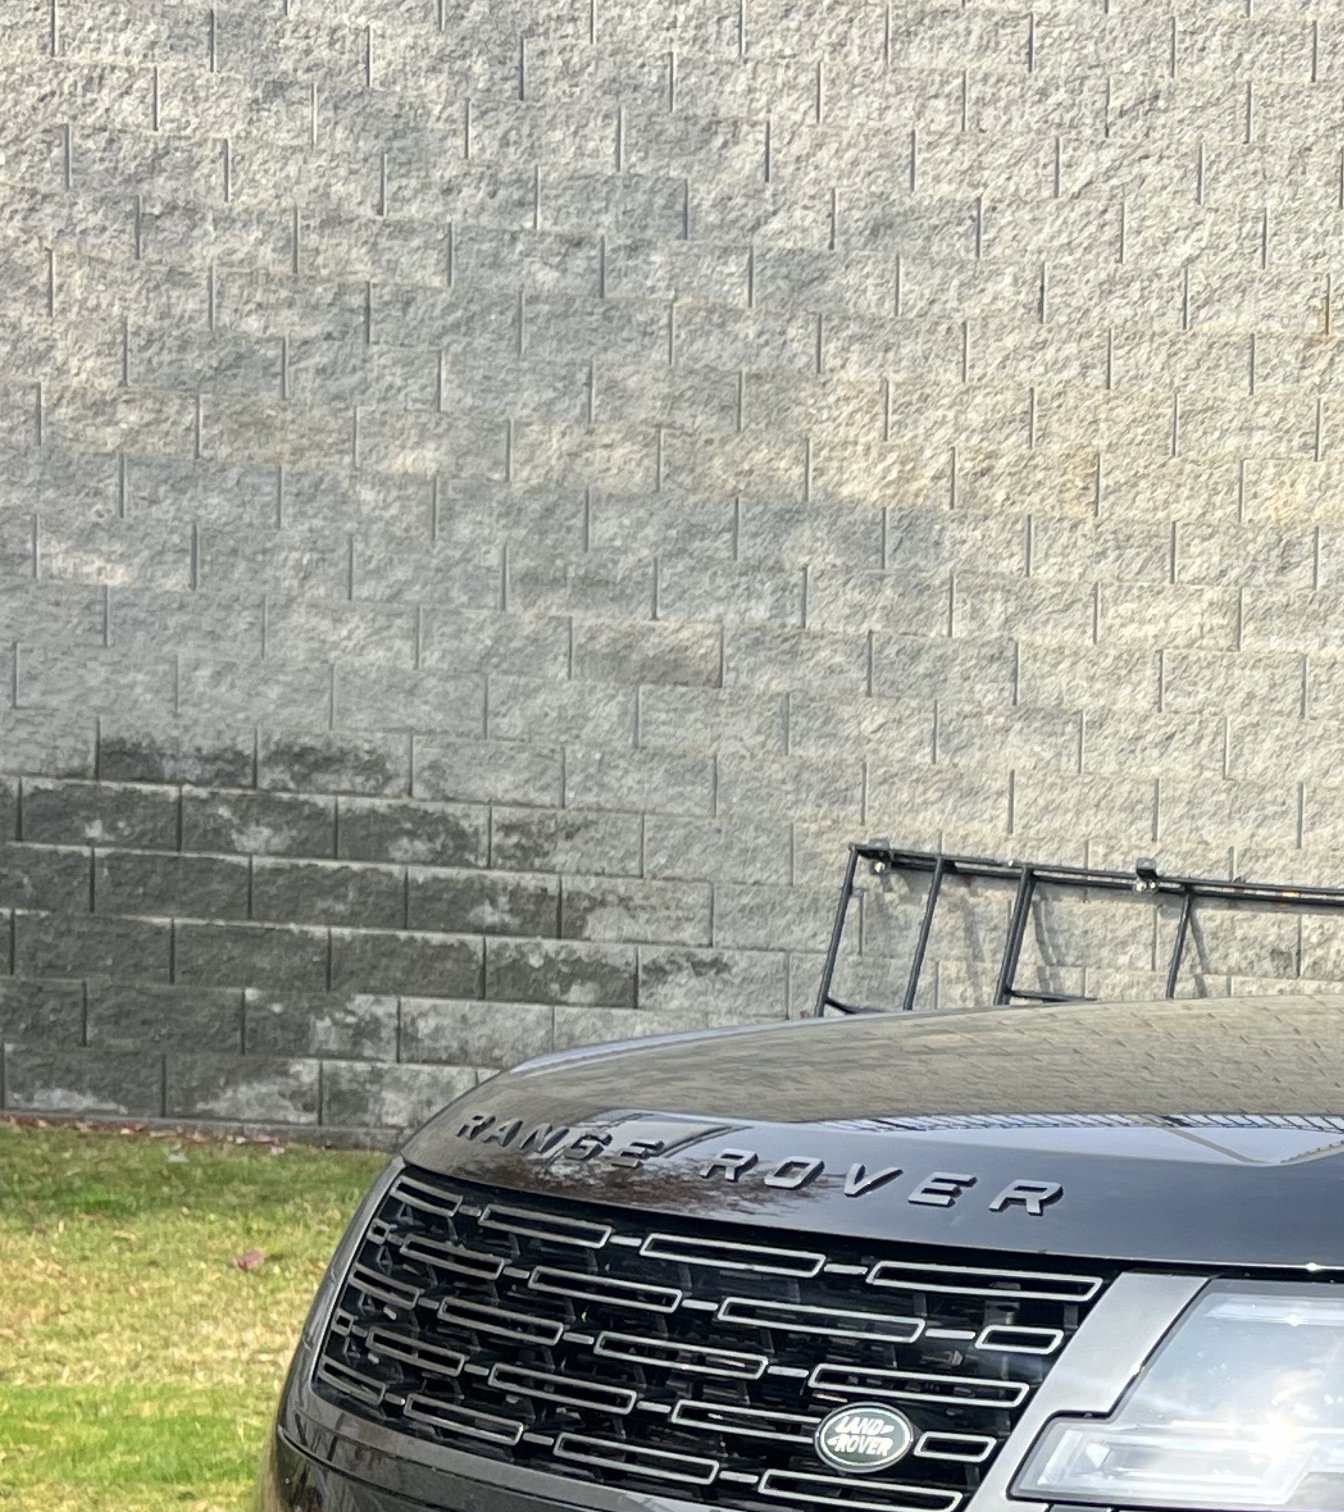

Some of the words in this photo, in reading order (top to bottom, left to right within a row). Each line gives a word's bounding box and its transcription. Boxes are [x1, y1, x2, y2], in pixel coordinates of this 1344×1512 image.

[456, 1113, 666, 1171] RANGE
[700, 1148, 1064, 1216] ROVER
[835, 1416, 885, 1435] LAND
[834, 1434, 894, 1457] ROVER
